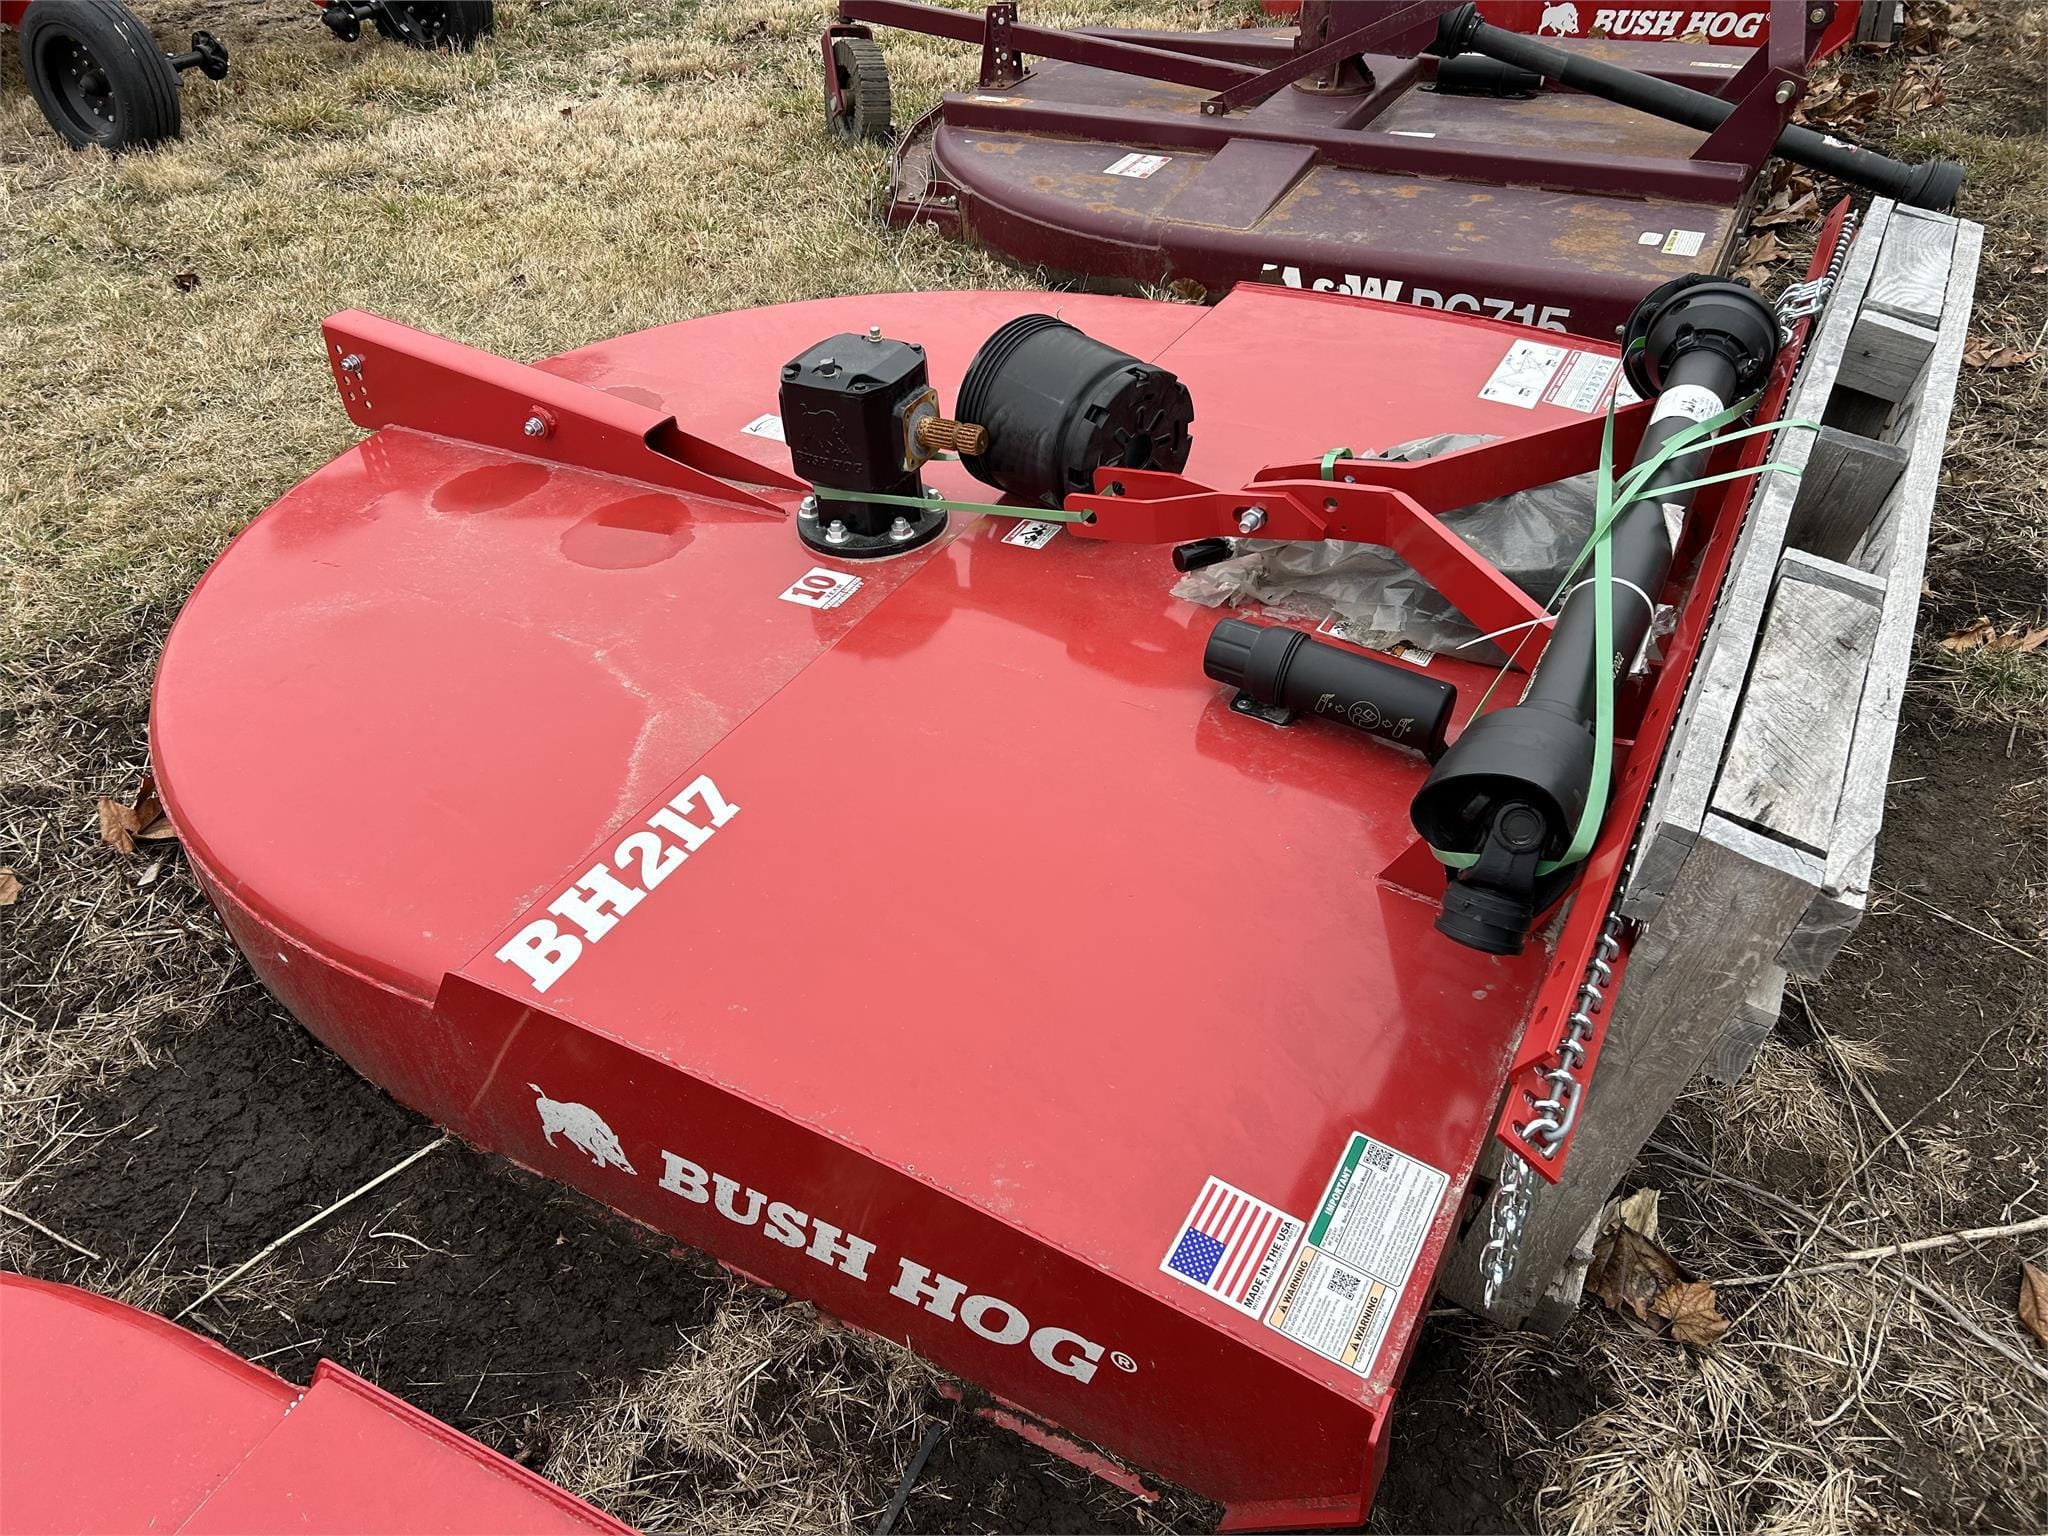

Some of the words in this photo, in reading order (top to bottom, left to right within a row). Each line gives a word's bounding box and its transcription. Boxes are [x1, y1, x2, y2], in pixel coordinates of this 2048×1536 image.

[1590, 9, 1684, 36] BUSH
[792, 576, 837, 600] 10
[824, 584, 844, 599] YEAR
[494, 774, 741, 993] BH217
[1324, 1165, 1352, 1216] IMPORTANT
[659, 1149, 876, 1281] BUSH
[1243, 1277, 1264, 1309] MADE
[1259, 1264, 1270, 1277] IN
[1265, 1242, 1281, 1263] THE
[1276, 1221, 1292, 1241] USA
[1282, 1260, 1308, 1303] WARNING
[1353, 1295, 1378, 1341] WARNING
